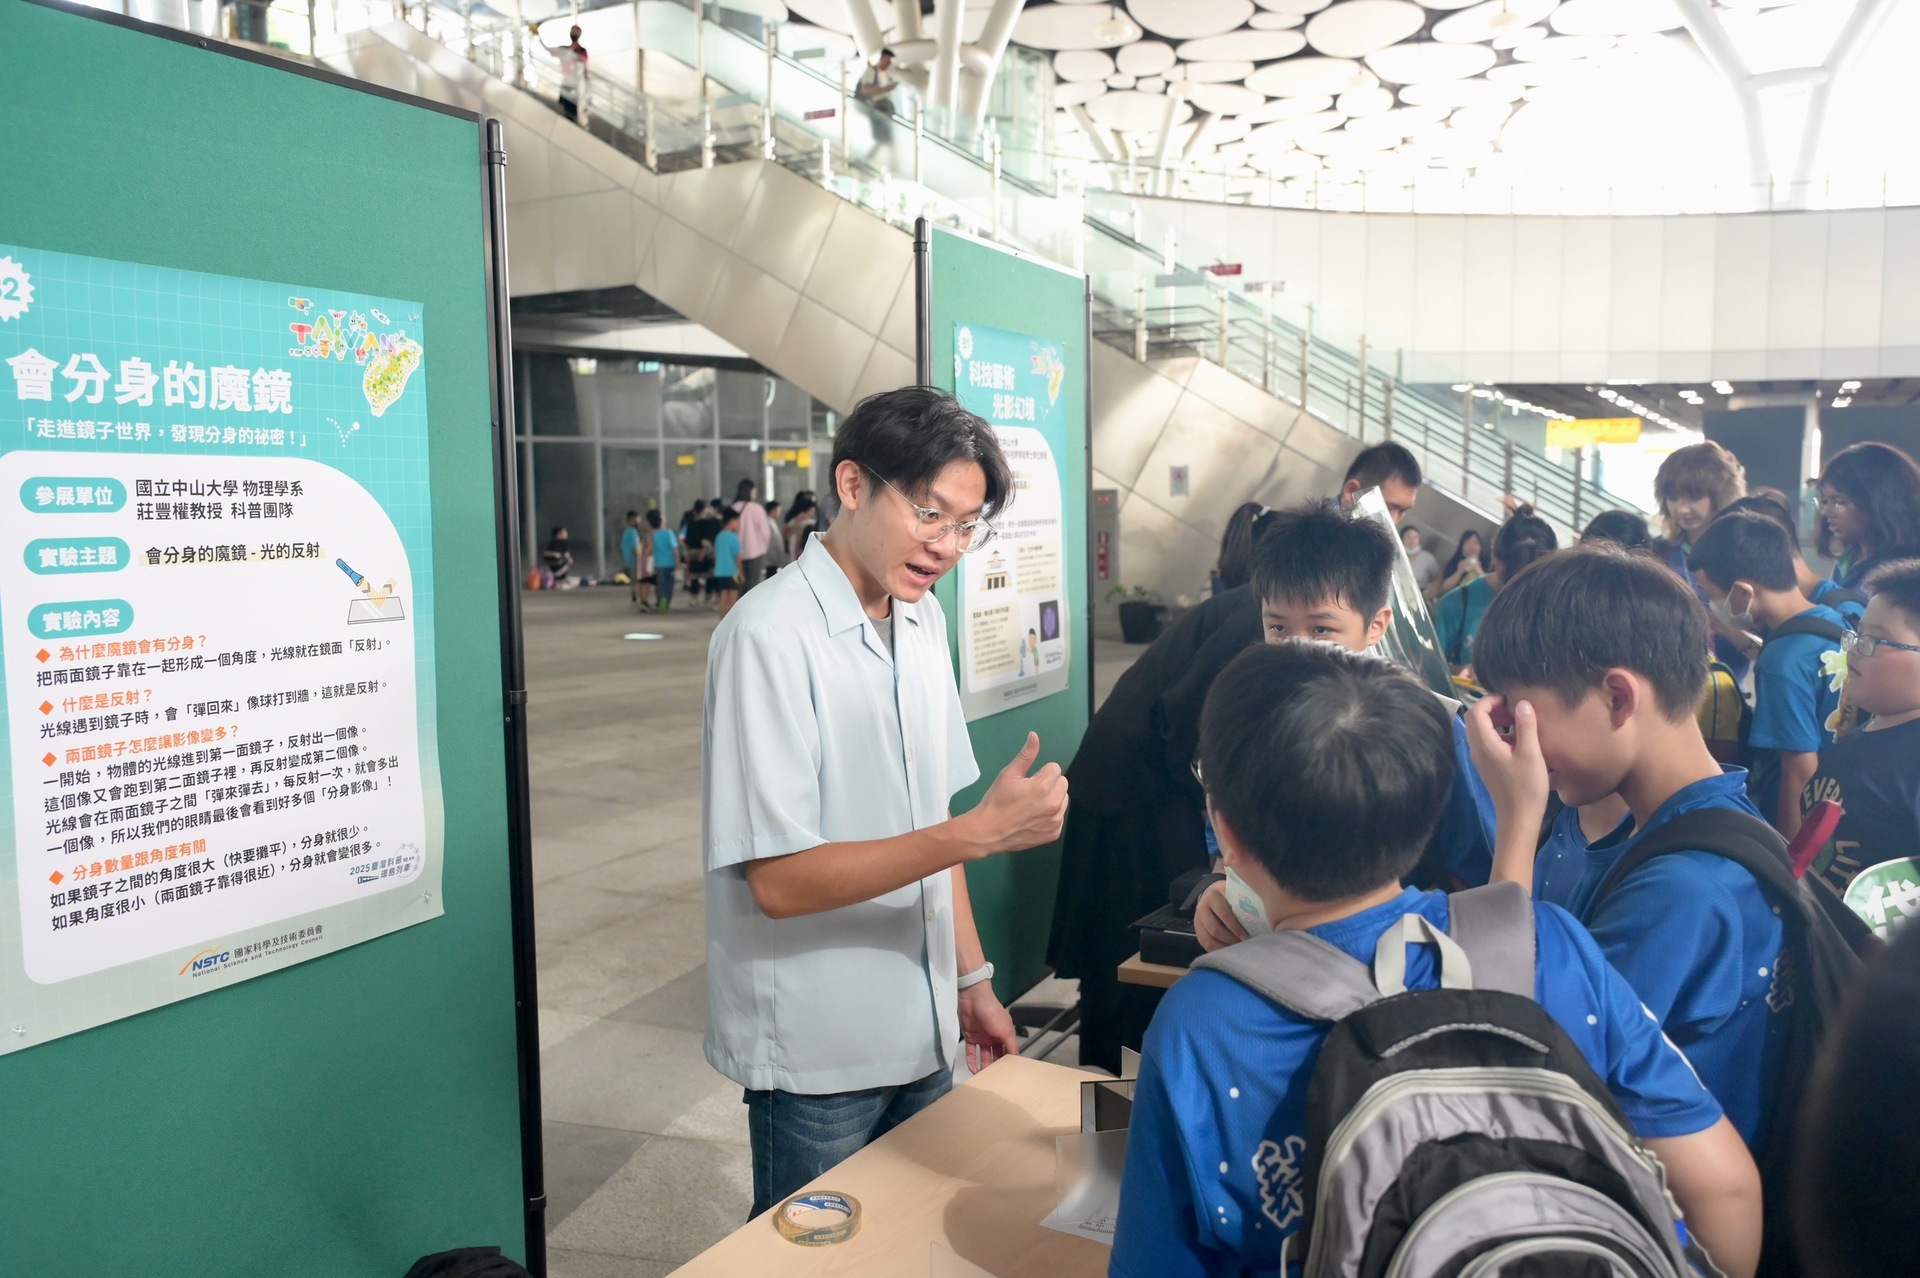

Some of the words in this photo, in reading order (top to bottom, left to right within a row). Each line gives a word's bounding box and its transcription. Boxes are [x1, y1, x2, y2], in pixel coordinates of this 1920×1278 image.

[5, 347, 293, 415] 會分身的魔鏡
[35, 485, 114, 507] 參展單位
[135, 478, 239, 498] 國立中山大學
[242, 479, 304, 498] 物理學系
[136, 502, 223, 521] 莊豐權教授
[230, 501, 294, 520] 科普團隊
[38, 545, 118, 568] 實驗主題
[145, 543, 248, 565] 會分身的魔鏡
[260, 541, 320, 561] 光的反射
[42, 607, 121, 632] 實驗內容
[59, 635, 207, 662] 為什麼魔鏡會有分身？
[62, 689, 152, 713] 什麼是反射？
[65, 725, 239, 765] 兩面鏡子怎麼讓影像變多？
[72, 838, 206, 882] 分身數量跟角度有關
[234, 924, 323, 959] 國家科學及技術委員會
[192, 965, 221, 979] National
[223, 957, 248, 969] Science
[251, 953, 262, 961] and
[265, 942, 299, 957] Technology
[301, 935, 323, 945] Council
[192, 951, 230, 972] NSTC
